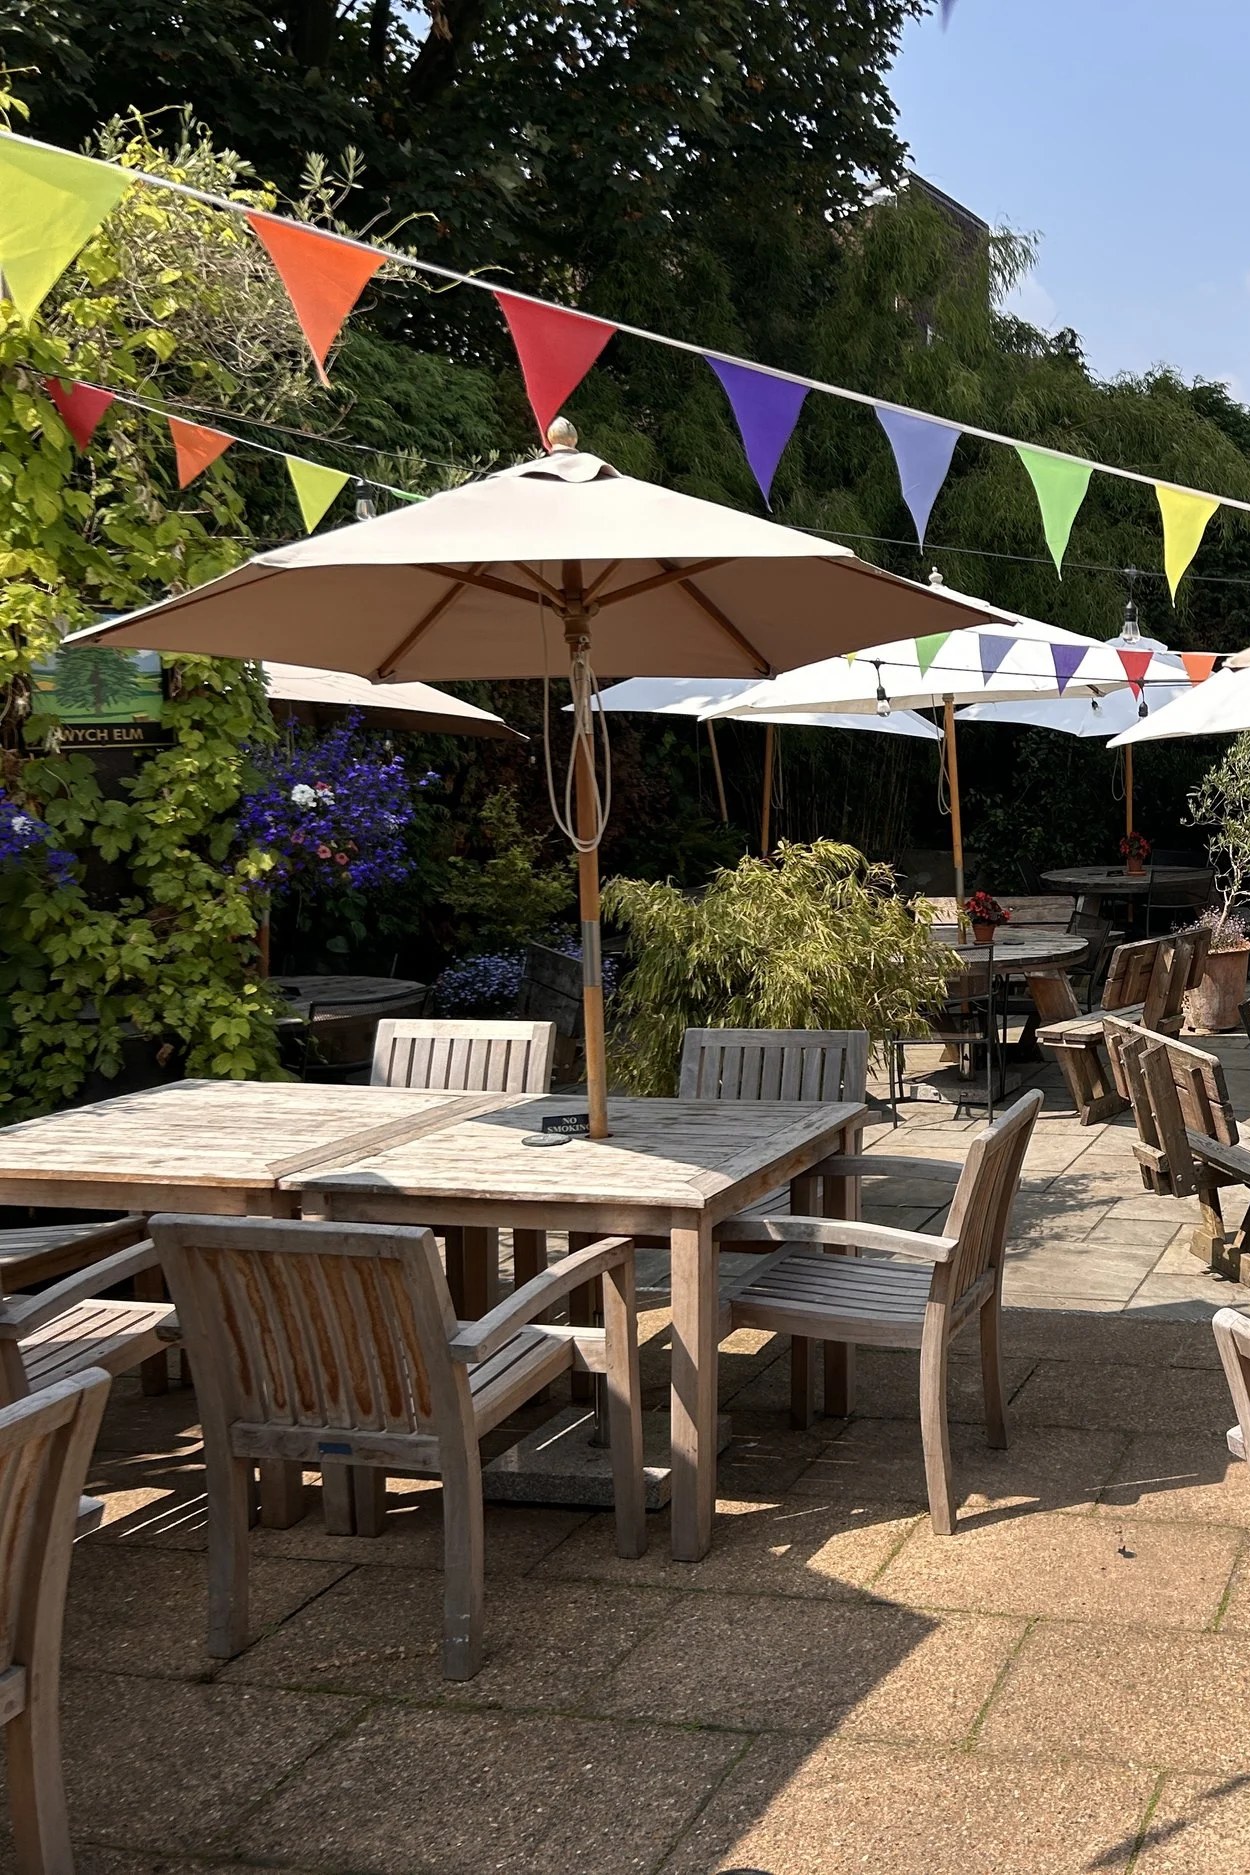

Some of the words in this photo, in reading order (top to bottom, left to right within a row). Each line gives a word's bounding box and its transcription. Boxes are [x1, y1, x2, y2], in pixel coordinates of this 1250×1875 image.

[61, 728, 108, 742] WYCH
[112, 728, 144, 741] ELM
[562, 1116, 578, 1125] NO
